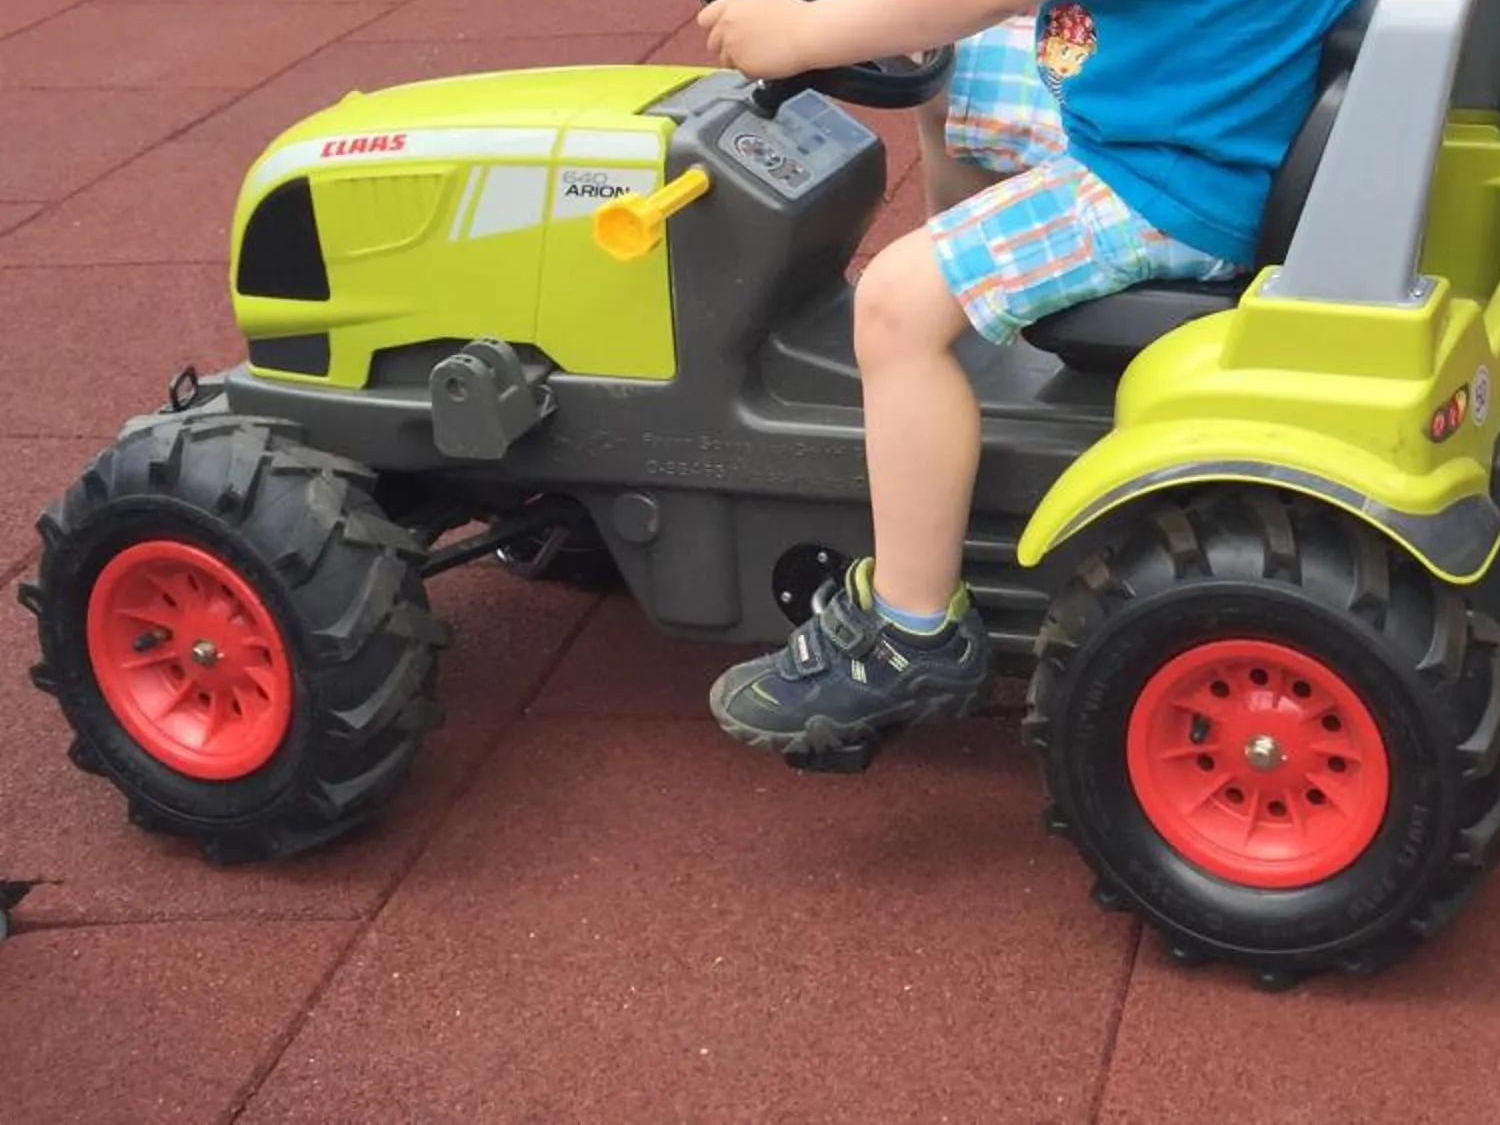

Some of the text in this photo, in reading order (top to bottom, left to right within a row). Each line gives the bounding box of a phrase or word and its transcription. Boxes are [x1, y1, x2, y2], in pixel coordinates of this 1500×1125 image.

[321, 134, 406, 157] CLAAS
[562, 170, 608, 184] 640
[565, 184, 630, 198] ARION
